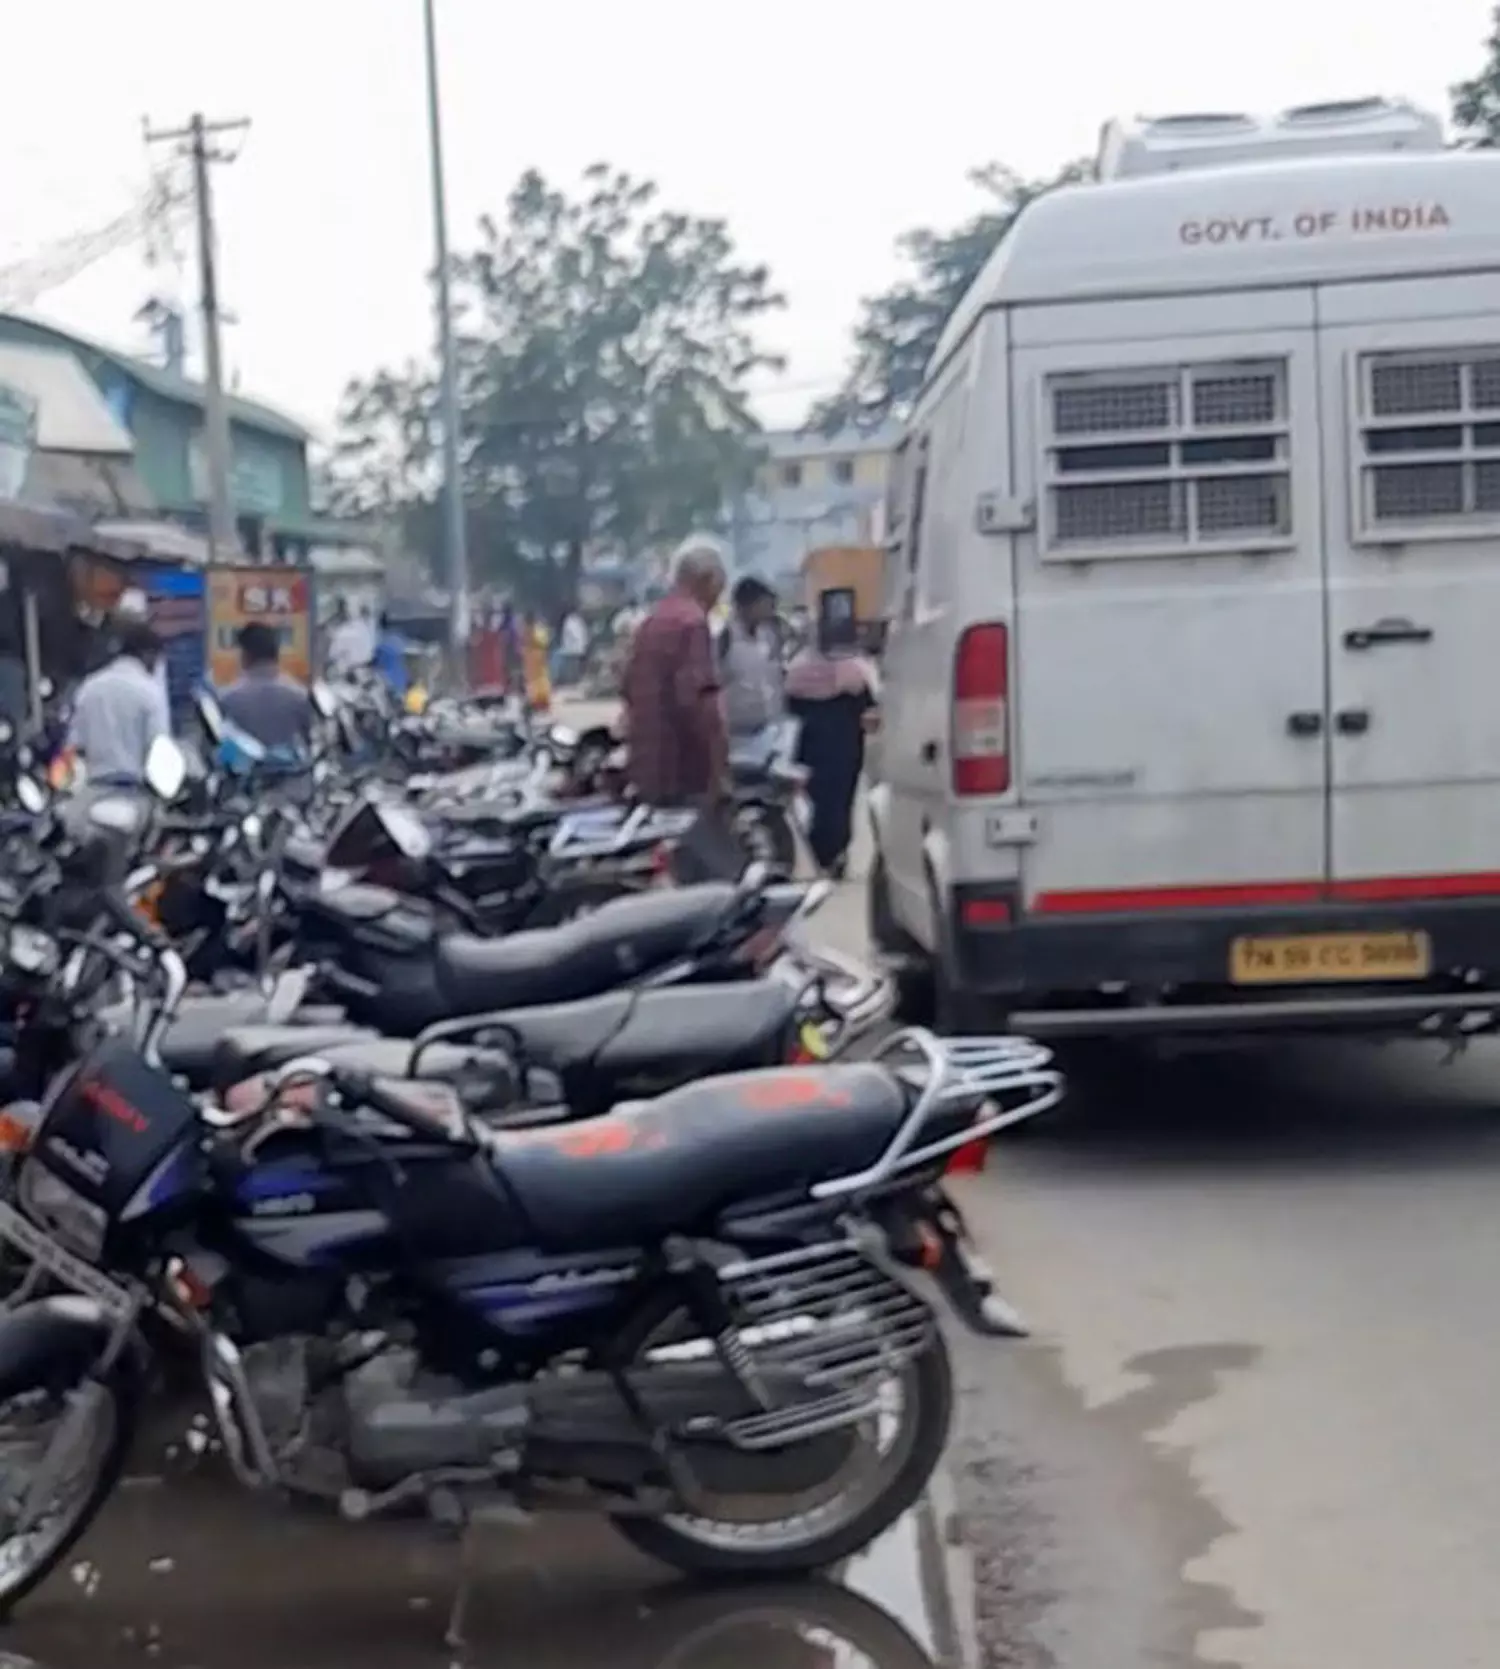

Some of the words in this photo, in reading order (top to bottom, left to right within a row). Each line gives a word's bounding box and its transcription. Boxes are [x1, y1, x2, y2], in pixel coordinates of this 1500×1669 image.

[1179, 218, 1283, 245] GOVT.
[1294, 212, 1338, 237] OF
[1351, 203, 1450, 231] INDIA
